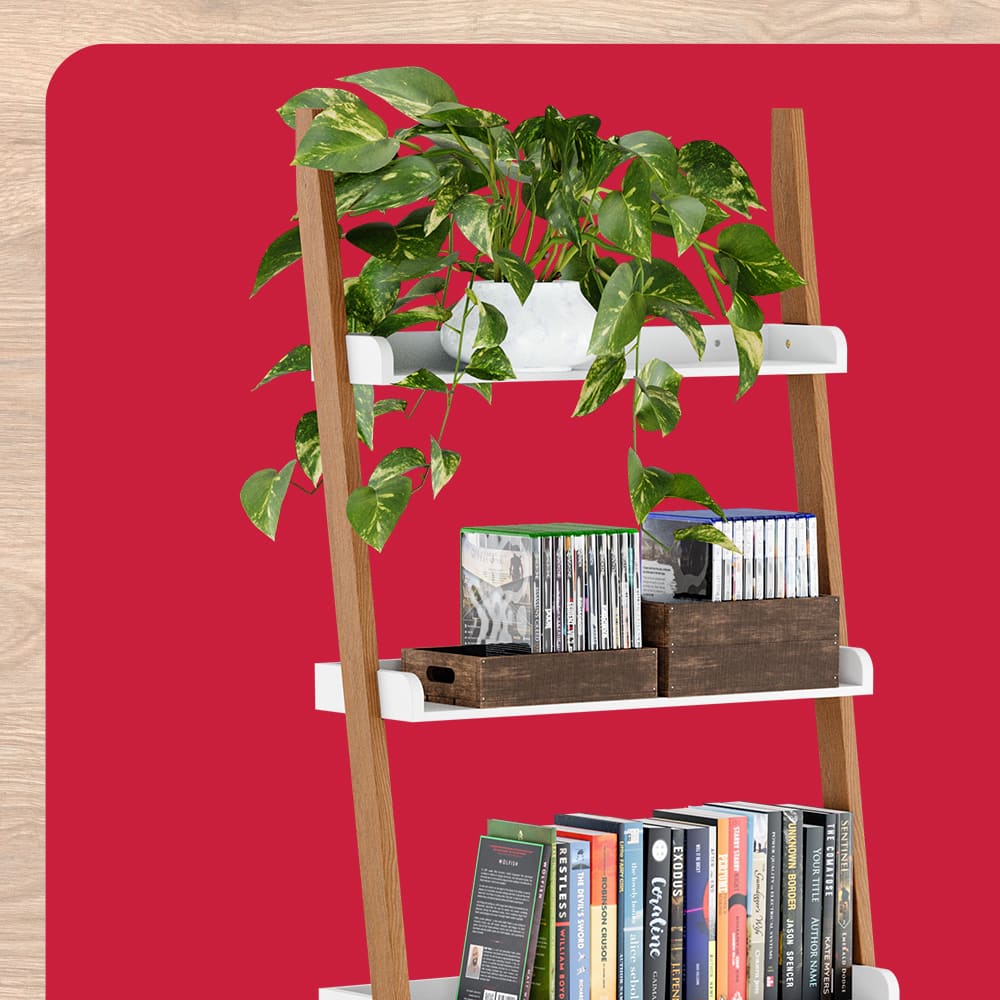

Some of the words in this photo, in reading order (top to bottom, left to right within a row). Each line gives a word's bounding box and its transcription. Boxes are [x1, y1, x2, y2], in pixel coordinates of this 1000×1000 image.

[788, 823, 797, 869] UNKNOWN
[827, 824, 835, 841] THE
[672, 846, 683, 897] EXODUS
[718, 853, 728, 894] PERFUME
[812, 848, 822, 877] YOUR
[825, 846, 834, 897] COMATOSE
[558, 847, 568, 919] RESTLESS
[577, 872, 585, 888] THE
[629, 876, 639, 900] lovely
[787, 874, 797, 911] BORDER
[811, 879, 820, 903] TITLE
[577, 889, 585, 917] DEVIL'S
[600, 876, 608, 926] ROBINSON
[649, 876, 667, 959] Coraline
[577, 919, 585, 949] SWORD
[600, 927, 608, 963] CRUSOE
[629, 933, 640, 963] alice
[786, 918, 794, 945] JASON
[810, 917, 820, 958] AUTHOR
[786, 951, 794, 988] SPENCER
[809, 960, 818, 988] NAME
[823, 962, 831, 995] MYERS
